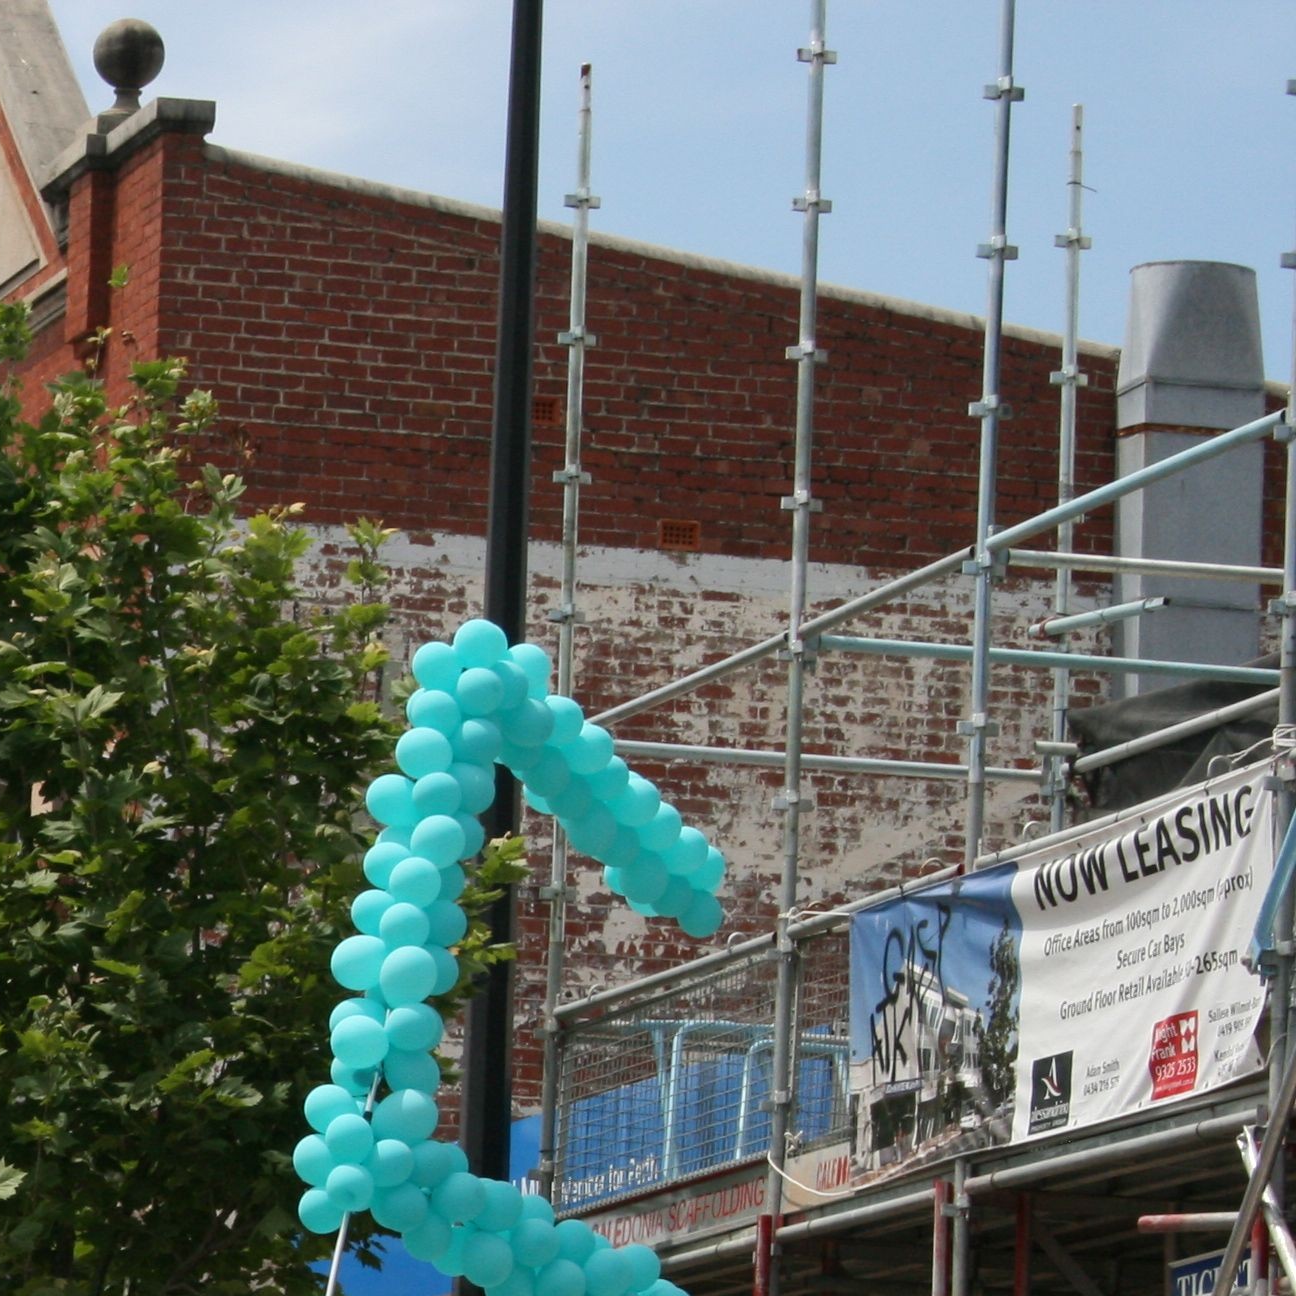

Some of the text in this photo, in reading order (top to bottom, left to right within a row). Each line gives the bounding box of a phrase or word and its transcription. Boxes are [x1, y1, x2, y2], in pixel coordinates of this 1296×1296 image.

[1034, 785, 1254, 911] NOW LEASING
[1044, 934, 1072, 957] Office
[1073, 926, 1100, 948] Areas
[1102, 918, 1124, 939] from
[1126, 907, 1159, 935] 100sqm
[1161, 903, 1171, 920] to
[1117, 931, 1185, 970] Secure Car Bays
[1060, 992, 1092, 1020] Ground
[1094, 986, 1117, 1011] Floor
[1119, 977, 1144, 1002] Retail
[668, 1175, 765, 1232] SCAFFOLDING
